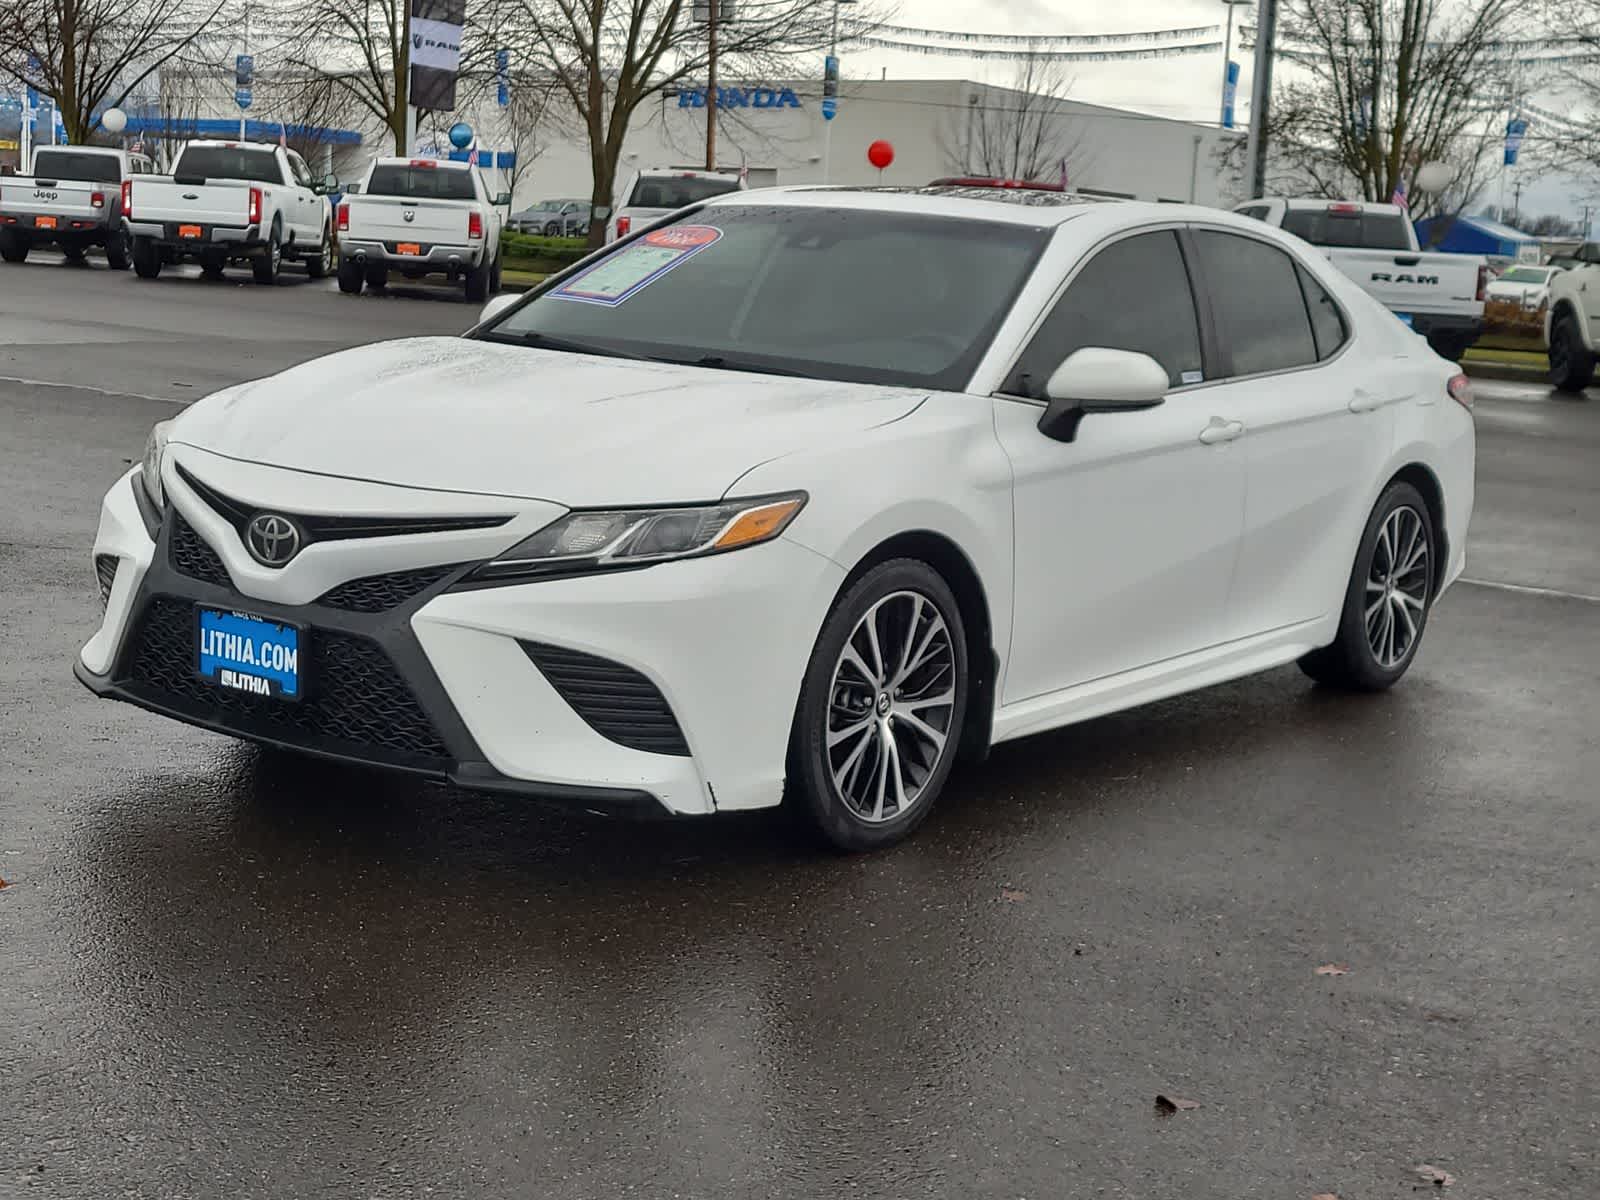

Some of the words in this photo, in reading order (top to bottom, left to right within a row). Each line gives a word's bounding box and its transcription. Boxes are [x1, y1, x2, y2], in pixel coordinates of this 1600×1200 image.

[425, 39, 460, 51] RAM
[678, 87, 801, 108] HONDA
[33, 189, 58, 200] Jeep
[1371, 273, 1439, 285] RAM
[200, 627, 298, 675] LITHIA.COM
[232, 671, 270, 696] LITHIA
